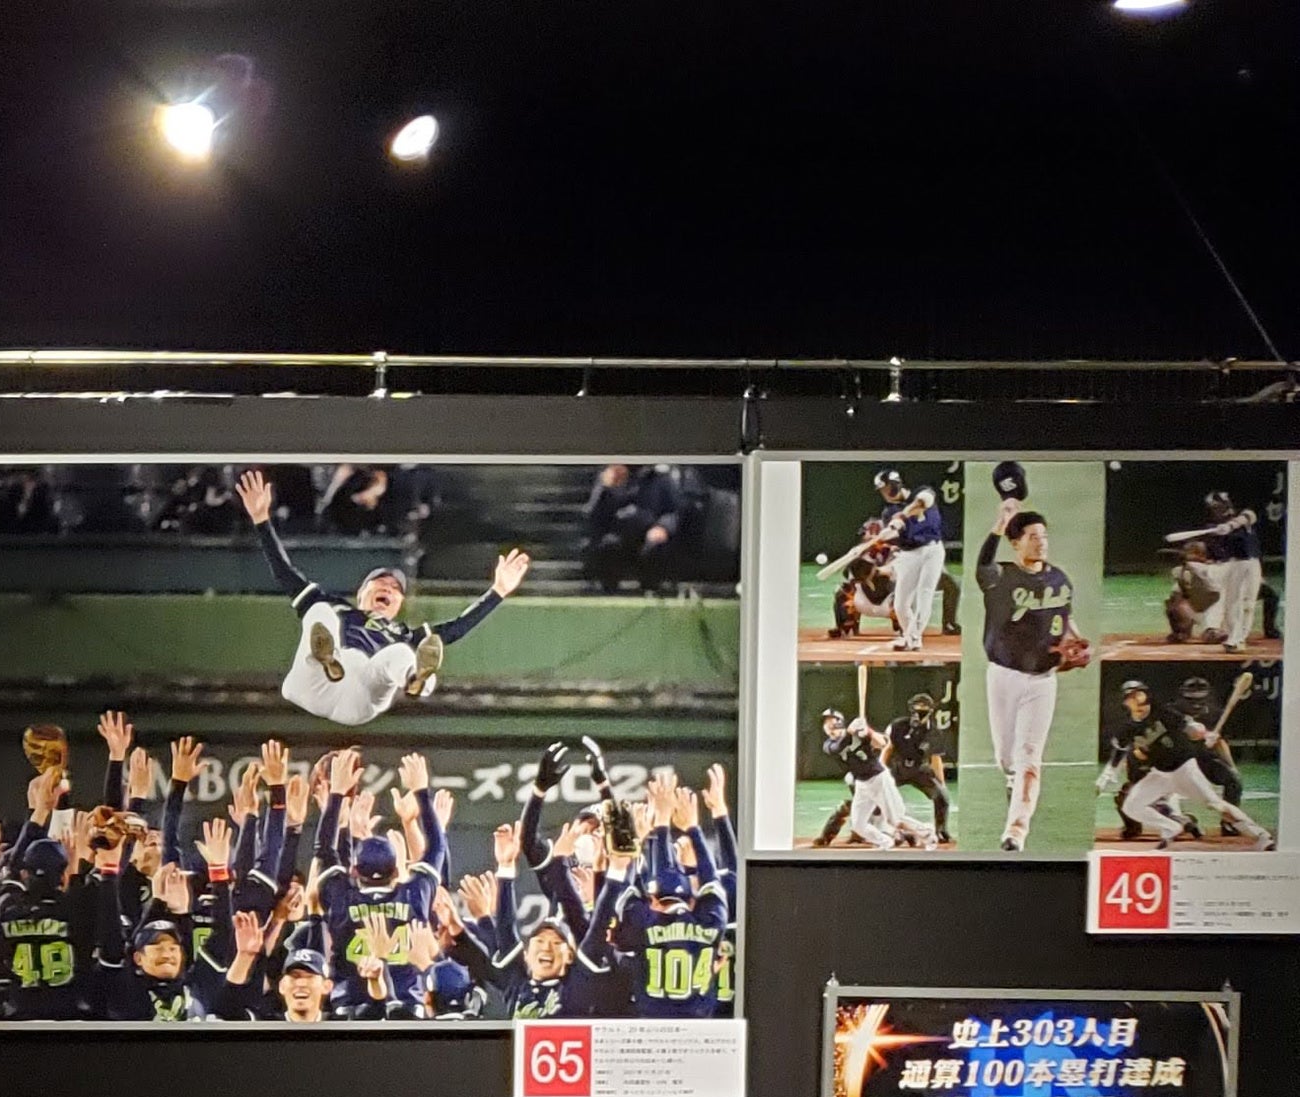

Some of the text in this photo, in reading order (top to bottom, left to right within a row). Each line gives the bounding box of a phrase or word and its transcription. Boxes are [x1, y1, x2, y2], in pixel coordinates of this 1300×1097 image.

[1104, 872, 1163, 914] 49
[12, 941, 75, 987] 48
[646, 947, 714, 999] 104
[948, 1018, 1139, 1049] 史上303人目
[530, 1040, 584, 1083] 65
[898, 1056, 1187, 1090] 通算100本塁打達成
